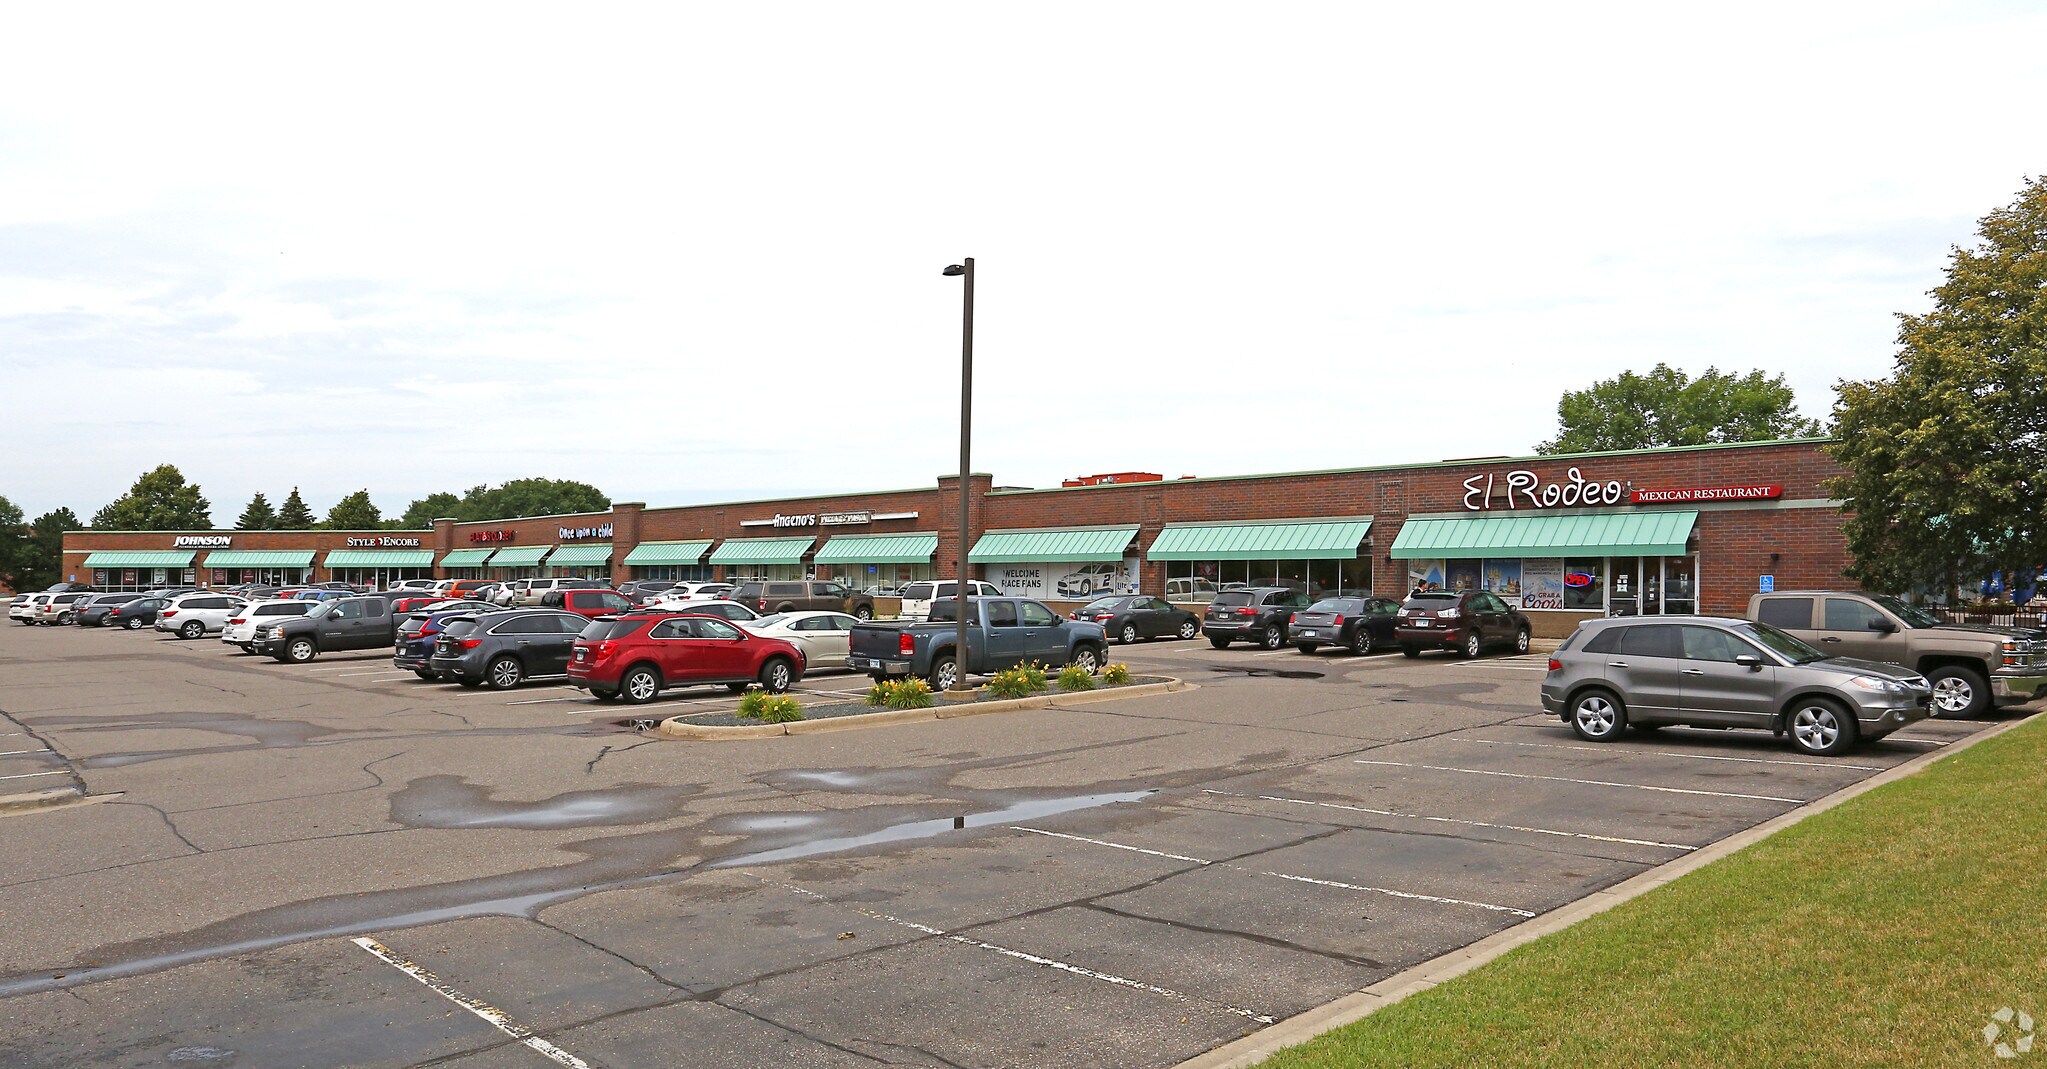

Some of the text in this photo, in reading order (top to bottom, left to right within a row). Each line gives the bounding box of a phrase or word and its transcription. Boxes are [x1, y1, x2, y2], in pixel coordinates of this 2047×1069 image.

[1463, 467, 1622, 510] El Rodeo
[1639, 487, 1771, 501] MEXICAN RESTAURANT
[559, 522, 613, 539] Once upon a child
[173, 536, 232, 547] JOHNSON
[347, 536, 419, 547] STYLE ENCORE
[1002, 569, 1040, 578] WELCOME
[1565, 574, 1590, 585] OPEN
[1001, 579, 1041, 588] RACE FANS
[1102, 574, 1111, 587] 2
[1522, 594, 1562, 609] Coors
